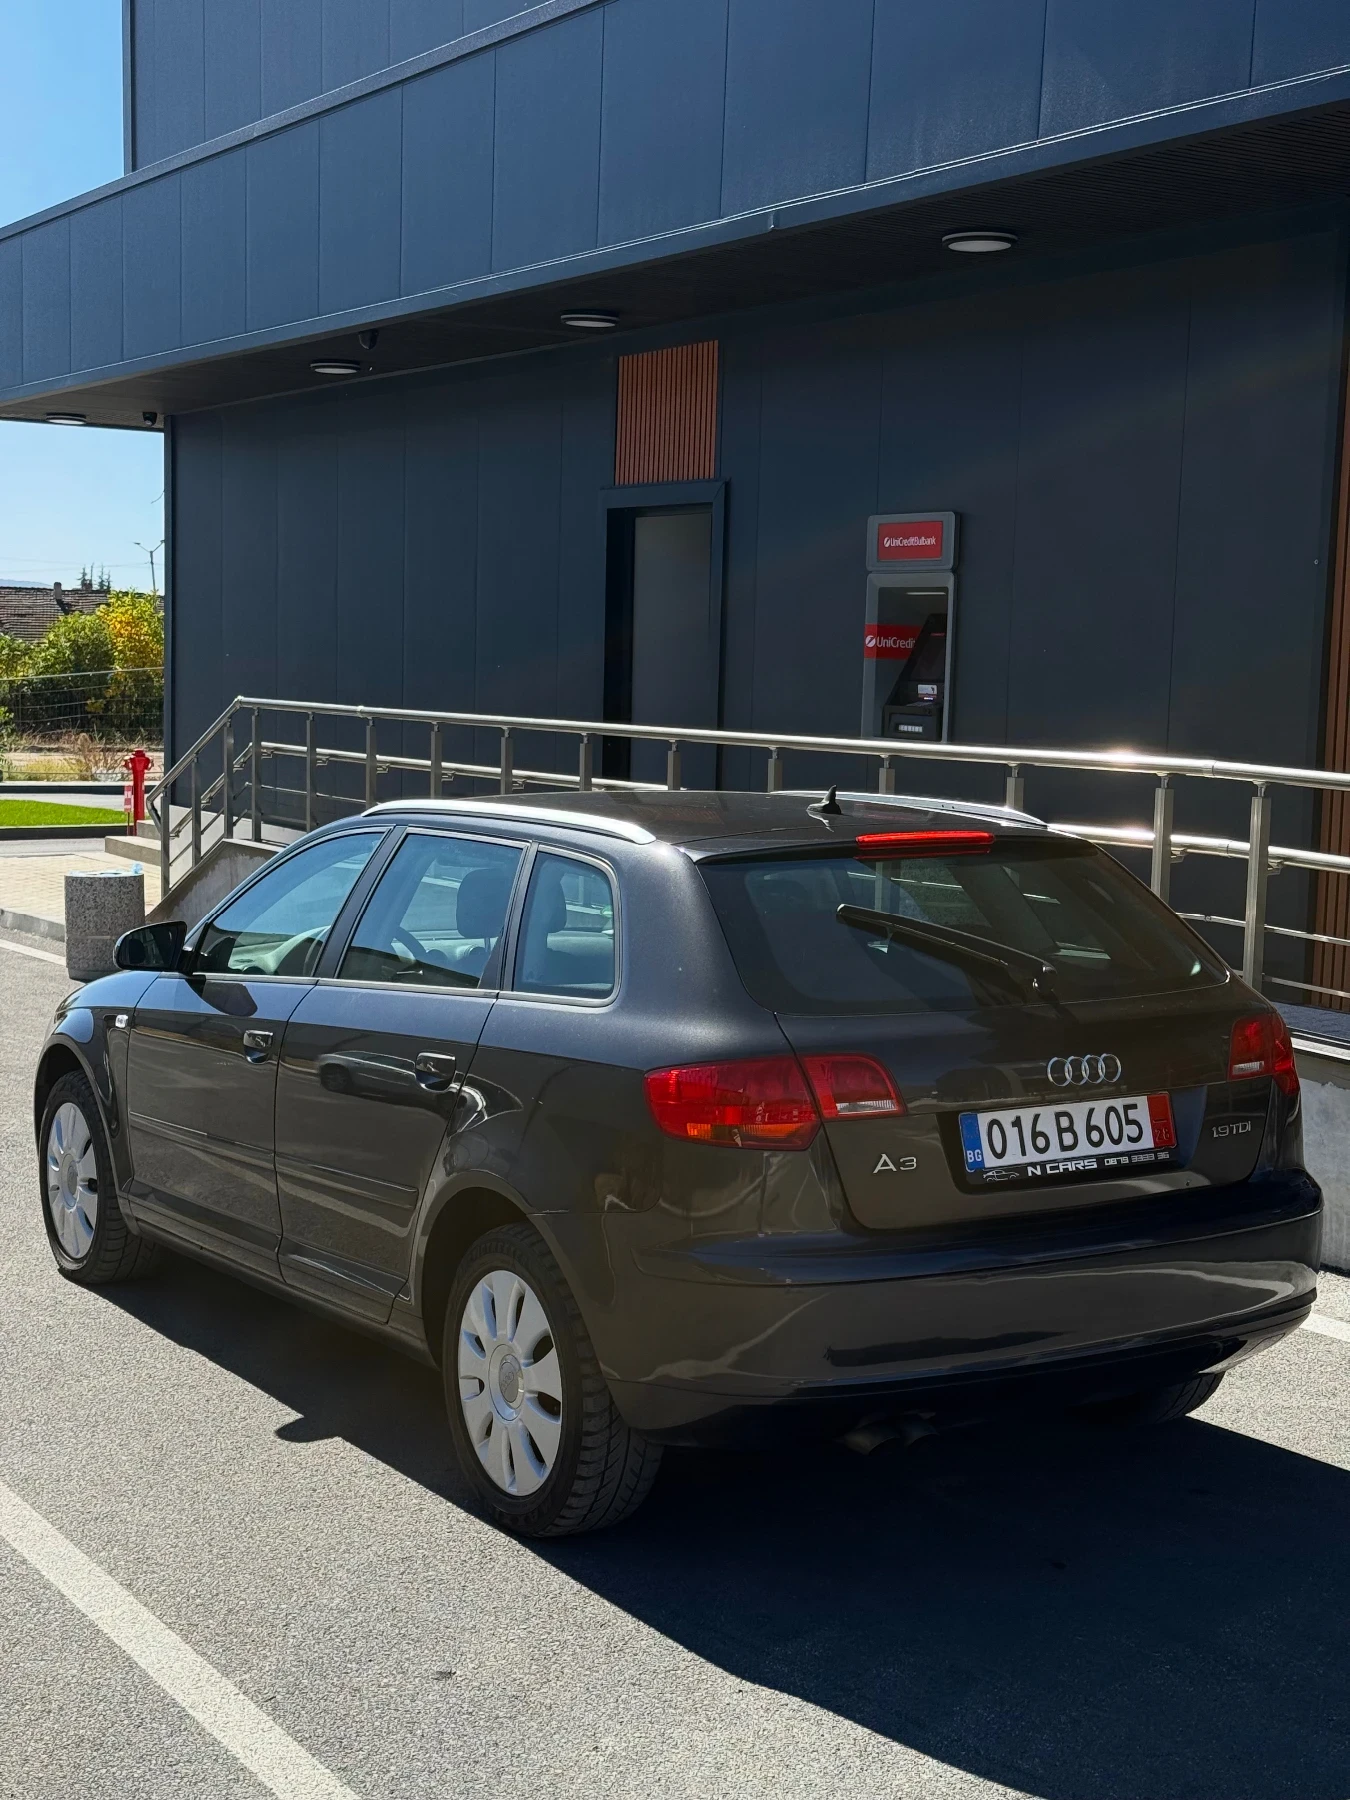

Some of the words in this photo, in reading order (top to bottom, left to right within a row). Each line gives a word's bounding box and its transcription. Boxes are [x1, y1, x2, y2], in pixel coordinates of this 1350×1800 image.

[872, 1153, 917, 1174] A3
[966, 1149, 983, 1163] BG
[1027, 1165, 1042, 1177] N
[1045, 1158, 1098, 1174] CARS
